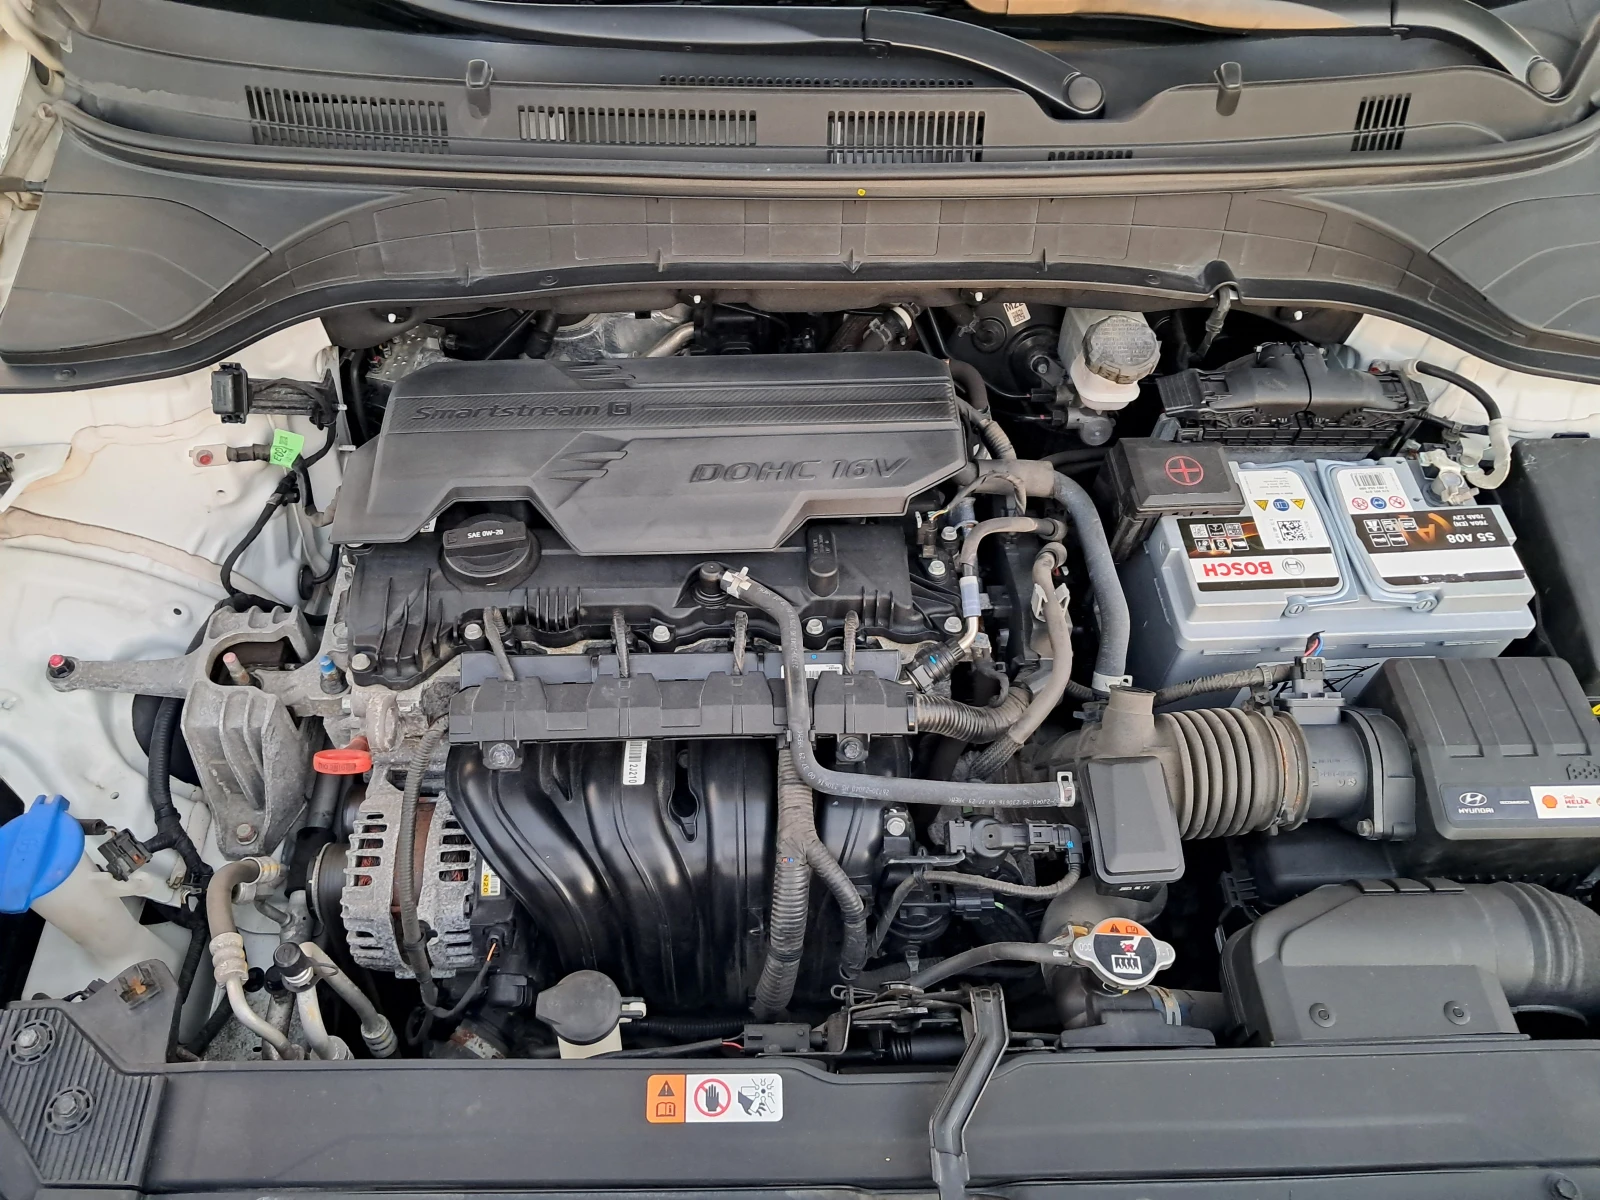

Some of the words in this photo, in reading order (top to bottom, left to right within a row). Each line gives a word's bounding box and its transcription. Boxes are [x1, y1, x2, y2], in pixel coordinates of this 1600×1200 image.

[412, 404, 600, 420] Smartstream
[689, 459, 822, 483] DOHC
[831, 457, 911, 480] 16V
[467, 531, 481, 539] SAE
[481, 528, 504, 537] 0W-20
[1445, 532, 1473, 544] A08
[1475, 531, 1496, 542] S5
[1202, 561, 1273, 577] BOSCH
[628, 763, 639, 783] 2J210
